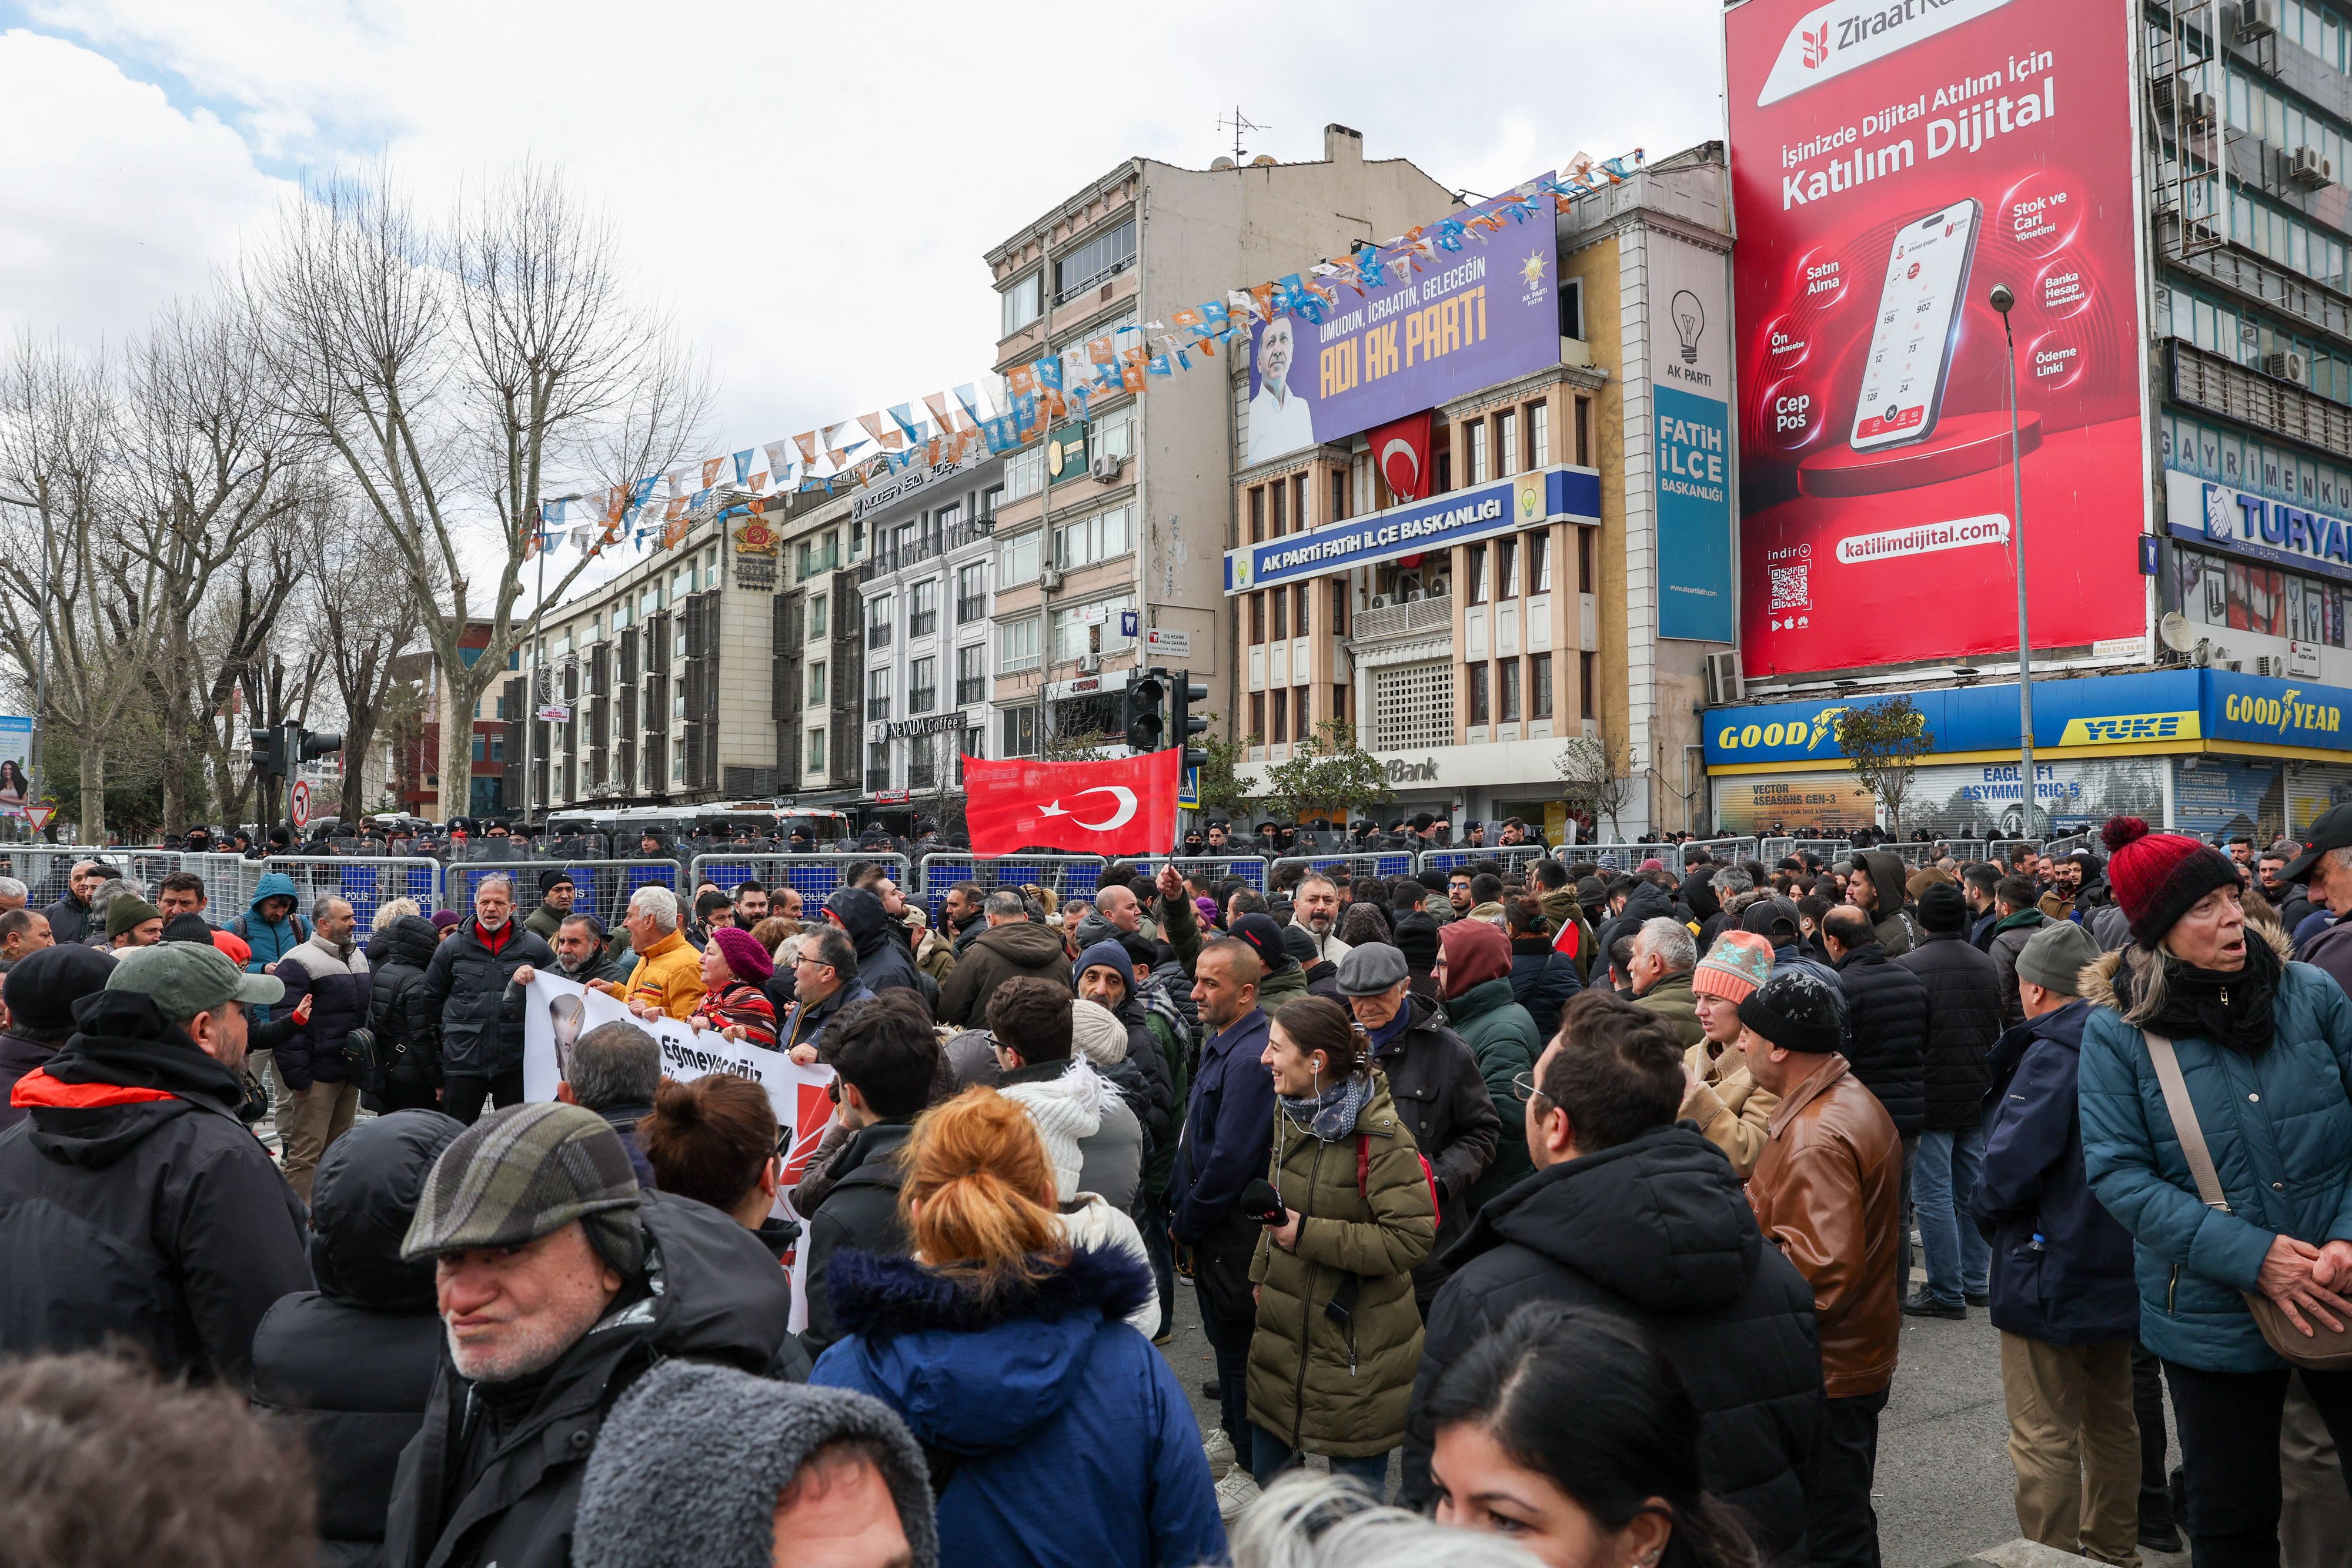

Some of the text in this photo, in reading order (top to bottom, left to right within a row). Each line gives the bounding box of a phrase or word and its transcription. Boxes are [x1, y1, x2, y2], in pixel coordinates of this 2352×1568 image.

[1838, 0, 1915, 50] Ziraat
[1783, 50, 2053, 169] İşinizde Dijital Atılım İçin
[1783, 76, 2054, 210] Katılım Dijital
[2013, 192, 2067, 217] Stok ve
[2014, 212, 2042, 230] Cari
[2015, 223, 2056, 242] Yönetimi
[1807, 262, 1839, 280] Satın
[1807, 277, 1840, 296] Alma
[2046, 272, 2079, 288] Banka
[1522, 293, 1531, 302] AK
[2046, 282, 2079, 299] Hesap
[1320, 256, 1485, 343] UMUDUN, İCRAATIN, GELECEĞİN
[1917, 302, 1930, 313] 902
[2046, 292, 2084, 307] Hareketleri
[1884, 315, 1895, 325] 156
[1320, 285, 1486, 400] ADI AK PARTİ
[1771, 332, 1788, 346] Ön
[1772, 340, 1805, 355] Muhasebe
[1909, 344, 1916, 353] 73
[2036, 347, 2077, 363] Ödeme
[1668, 364, 1711, 387] AK PARTİ
[2037, 362, 2063, 377] Linki
[1900, 384, 1908, 393] 24
[1776, 394, 1810, 414] Cep
[1867, 393, 1877, 402] 128
[1777, 413, 1806, 432] Pos
[1660, 415, 1722, 453] FATİH
[1661, 442, 1722, 483] İLÇE
[864, 473, 922, 510] MODERNİSTA
[1662, 478, 1723, 502] BAŞKANLIĞI
[1262, 499, 1502, 573] AK PARTİ FATİH İLÇE BAŞKANLIĞI
[2237, 493, 2352, 564] TURYA
[1845, 521, 1999, 558] katilimdijital.com
[1768, 548, 1797, 560] indir
[2259, 547, 2279, 560] ALPHA
[891, 716, 958, 738] NEVADA Coffee
[2084, 716, 2179, 740] YUKE
[1983, 765, 2053, 782] EAGL F1
[1753, 784, 1789, 794] VECTOR
[2069, 781, 2080, 797] 5
[1753, 794, 1836, 805] 4SEASONS GEN-3
[346, 891, 369, 901] POLİS
[413, 894, 432, 903] POL
[800, 891, 827, 901] POLİS
[1074, 886, 1098, 896] POLİS
